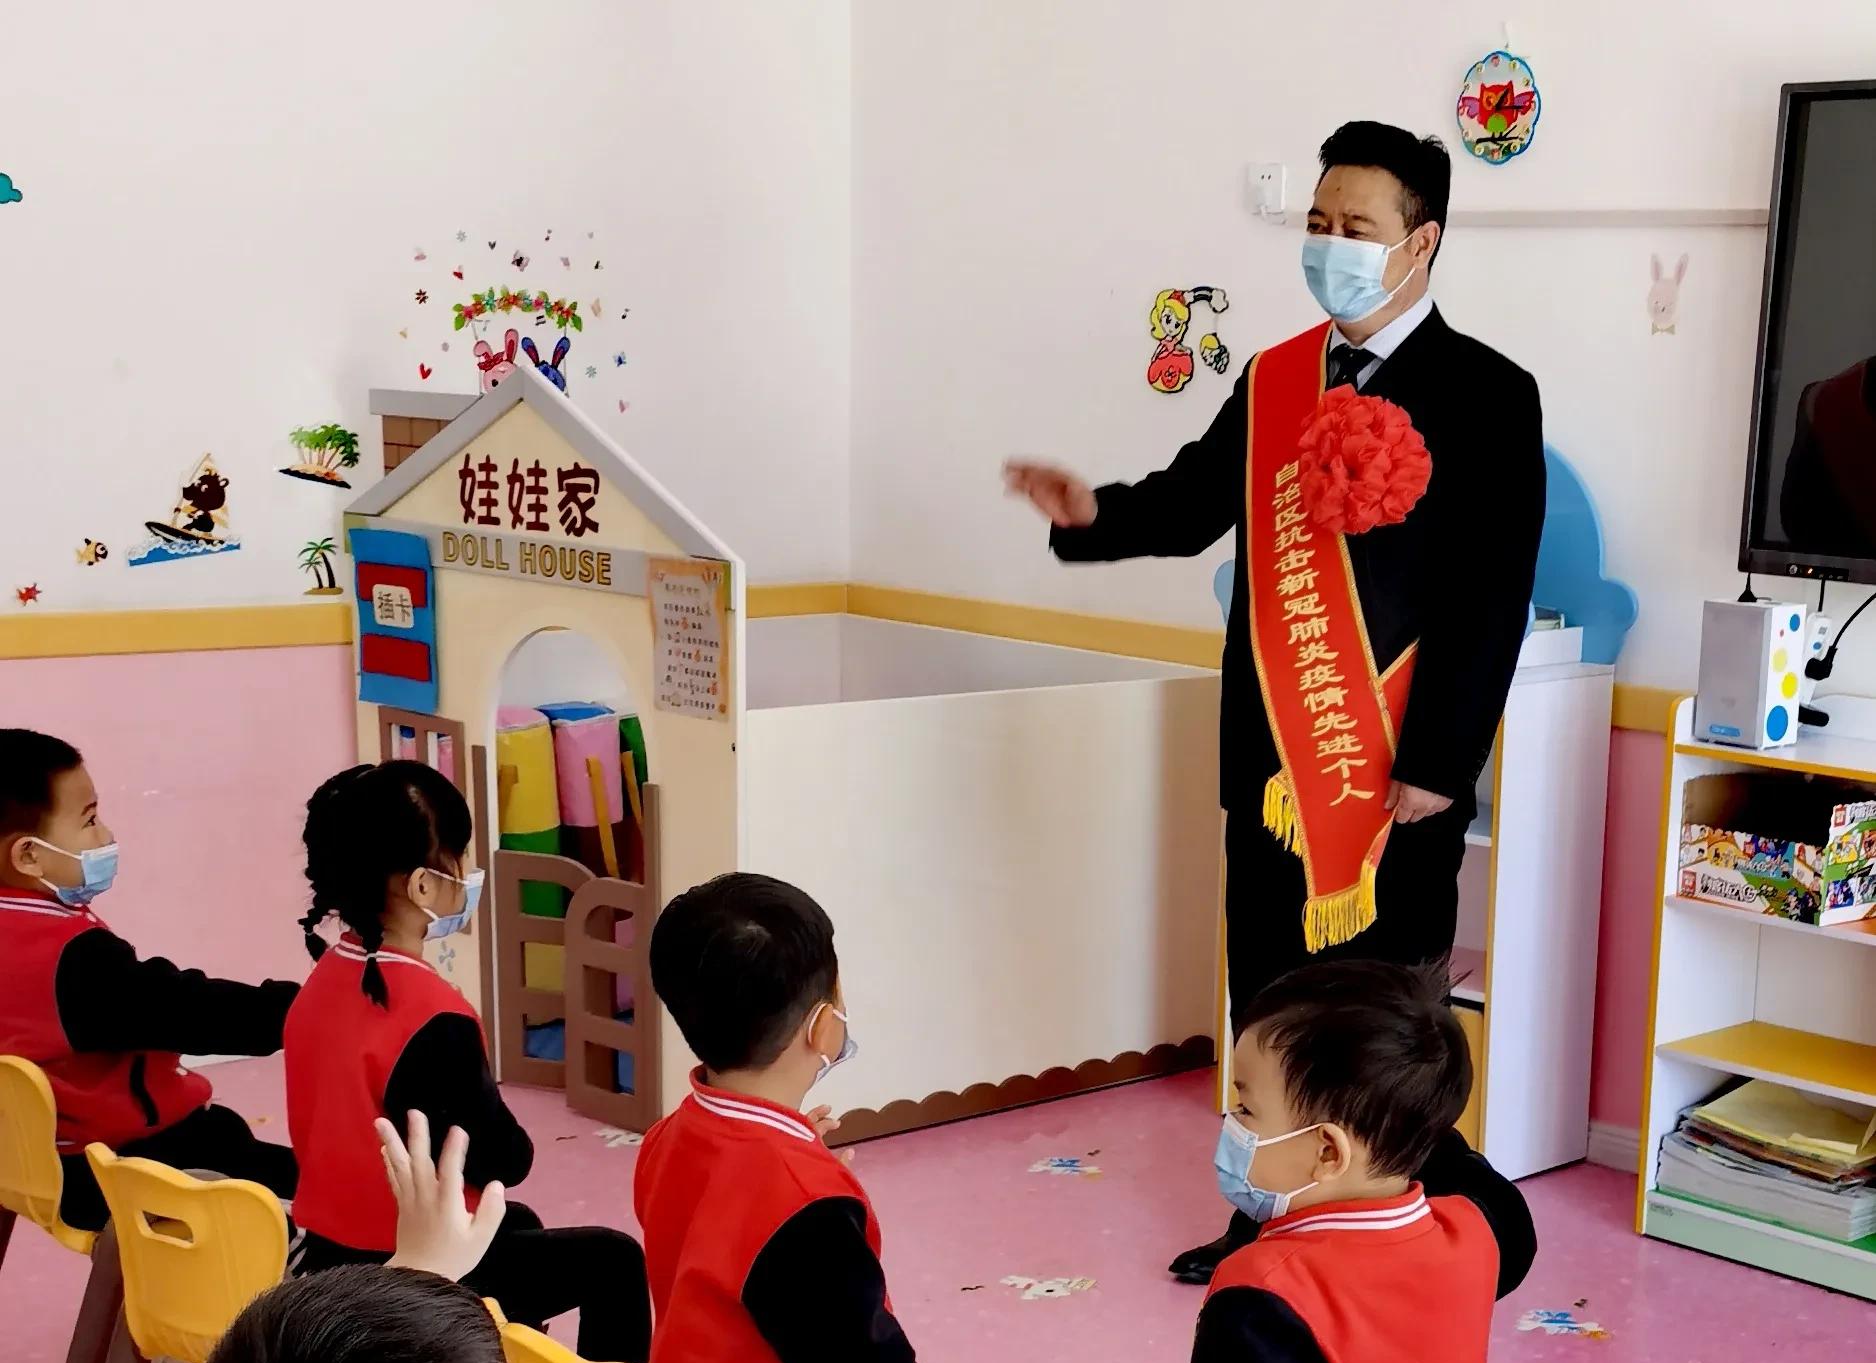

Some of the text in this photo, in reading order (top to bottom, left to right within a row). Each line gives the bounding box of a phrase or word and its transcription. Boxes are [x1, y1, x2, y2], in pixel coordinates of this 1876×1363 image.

[459, 453, 600, 537] 娃娃家
[443, 531, 612, 585] DOLL HOUSE
[1272, 460, 1374, 804] 自治区抗击新冠肺炎疫情先进个人
